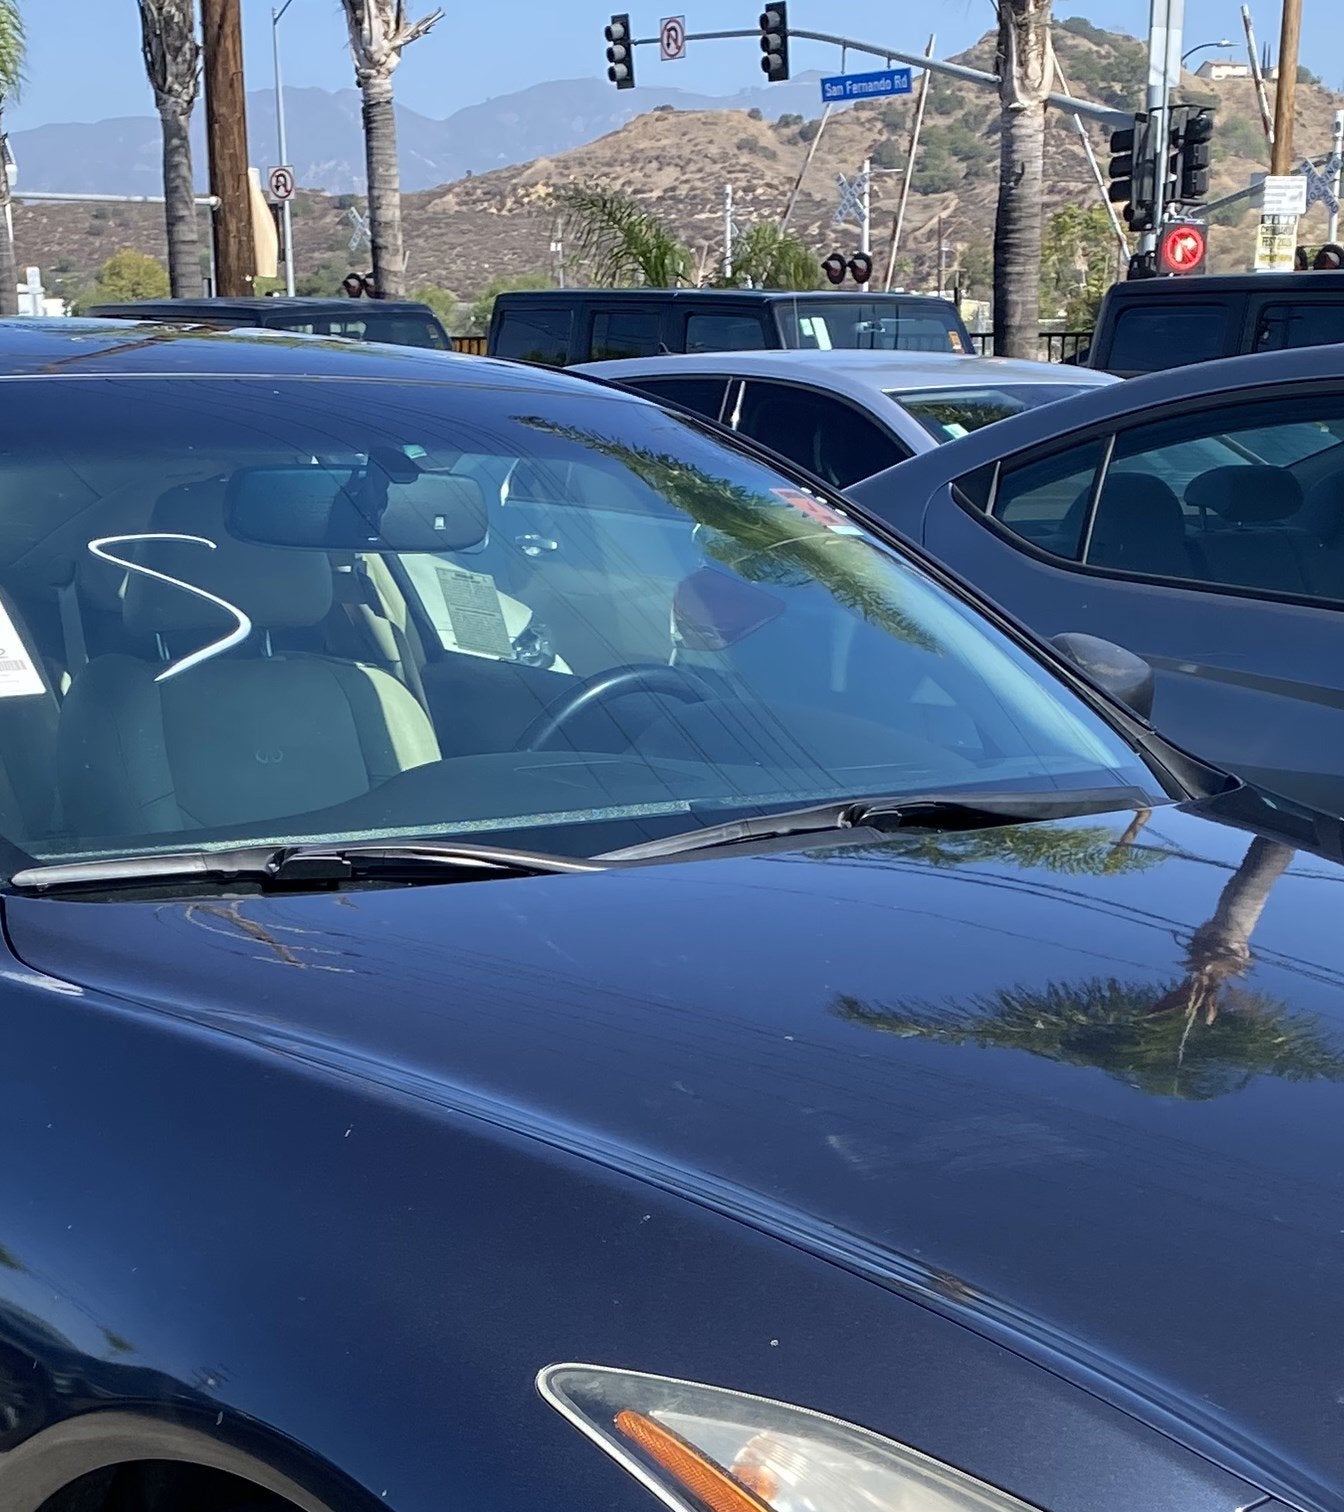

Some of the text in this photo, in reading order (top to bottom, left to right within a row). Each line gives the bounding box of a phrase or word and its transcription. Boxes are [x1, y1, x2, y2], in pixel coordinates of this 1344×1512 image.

[824, 75, 908, 97] San Fernando Rd
